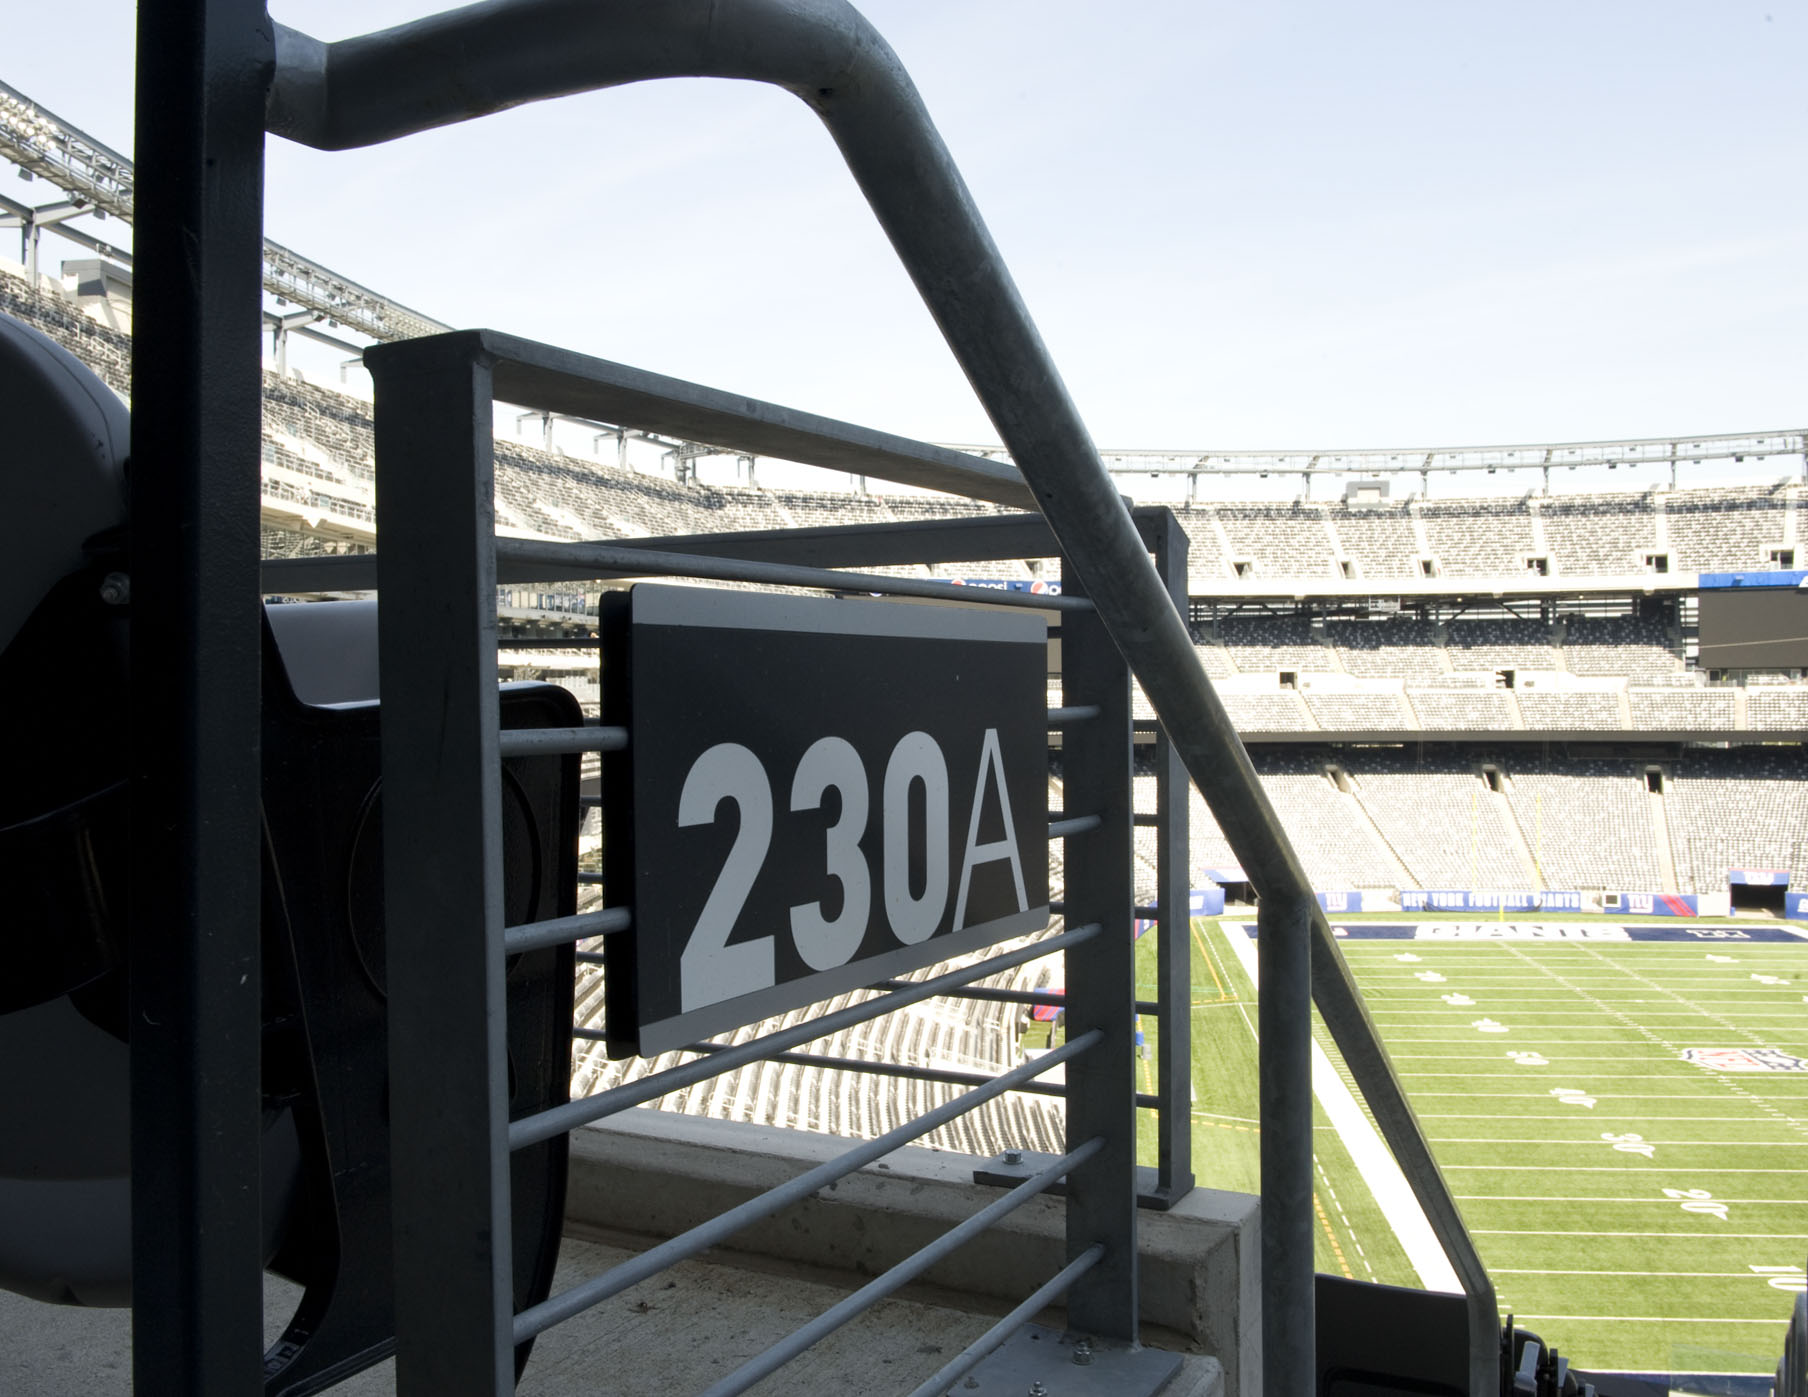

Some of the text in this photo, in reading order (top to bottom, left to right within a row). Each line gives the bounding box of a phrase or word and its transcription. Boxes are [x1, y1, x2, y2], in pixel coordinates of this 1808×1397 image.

[678, 728, 1030, 1014] 230A
[1600, 1133, 1655, 1152] 30
[1662, 1188, 1728, 1213] 20
